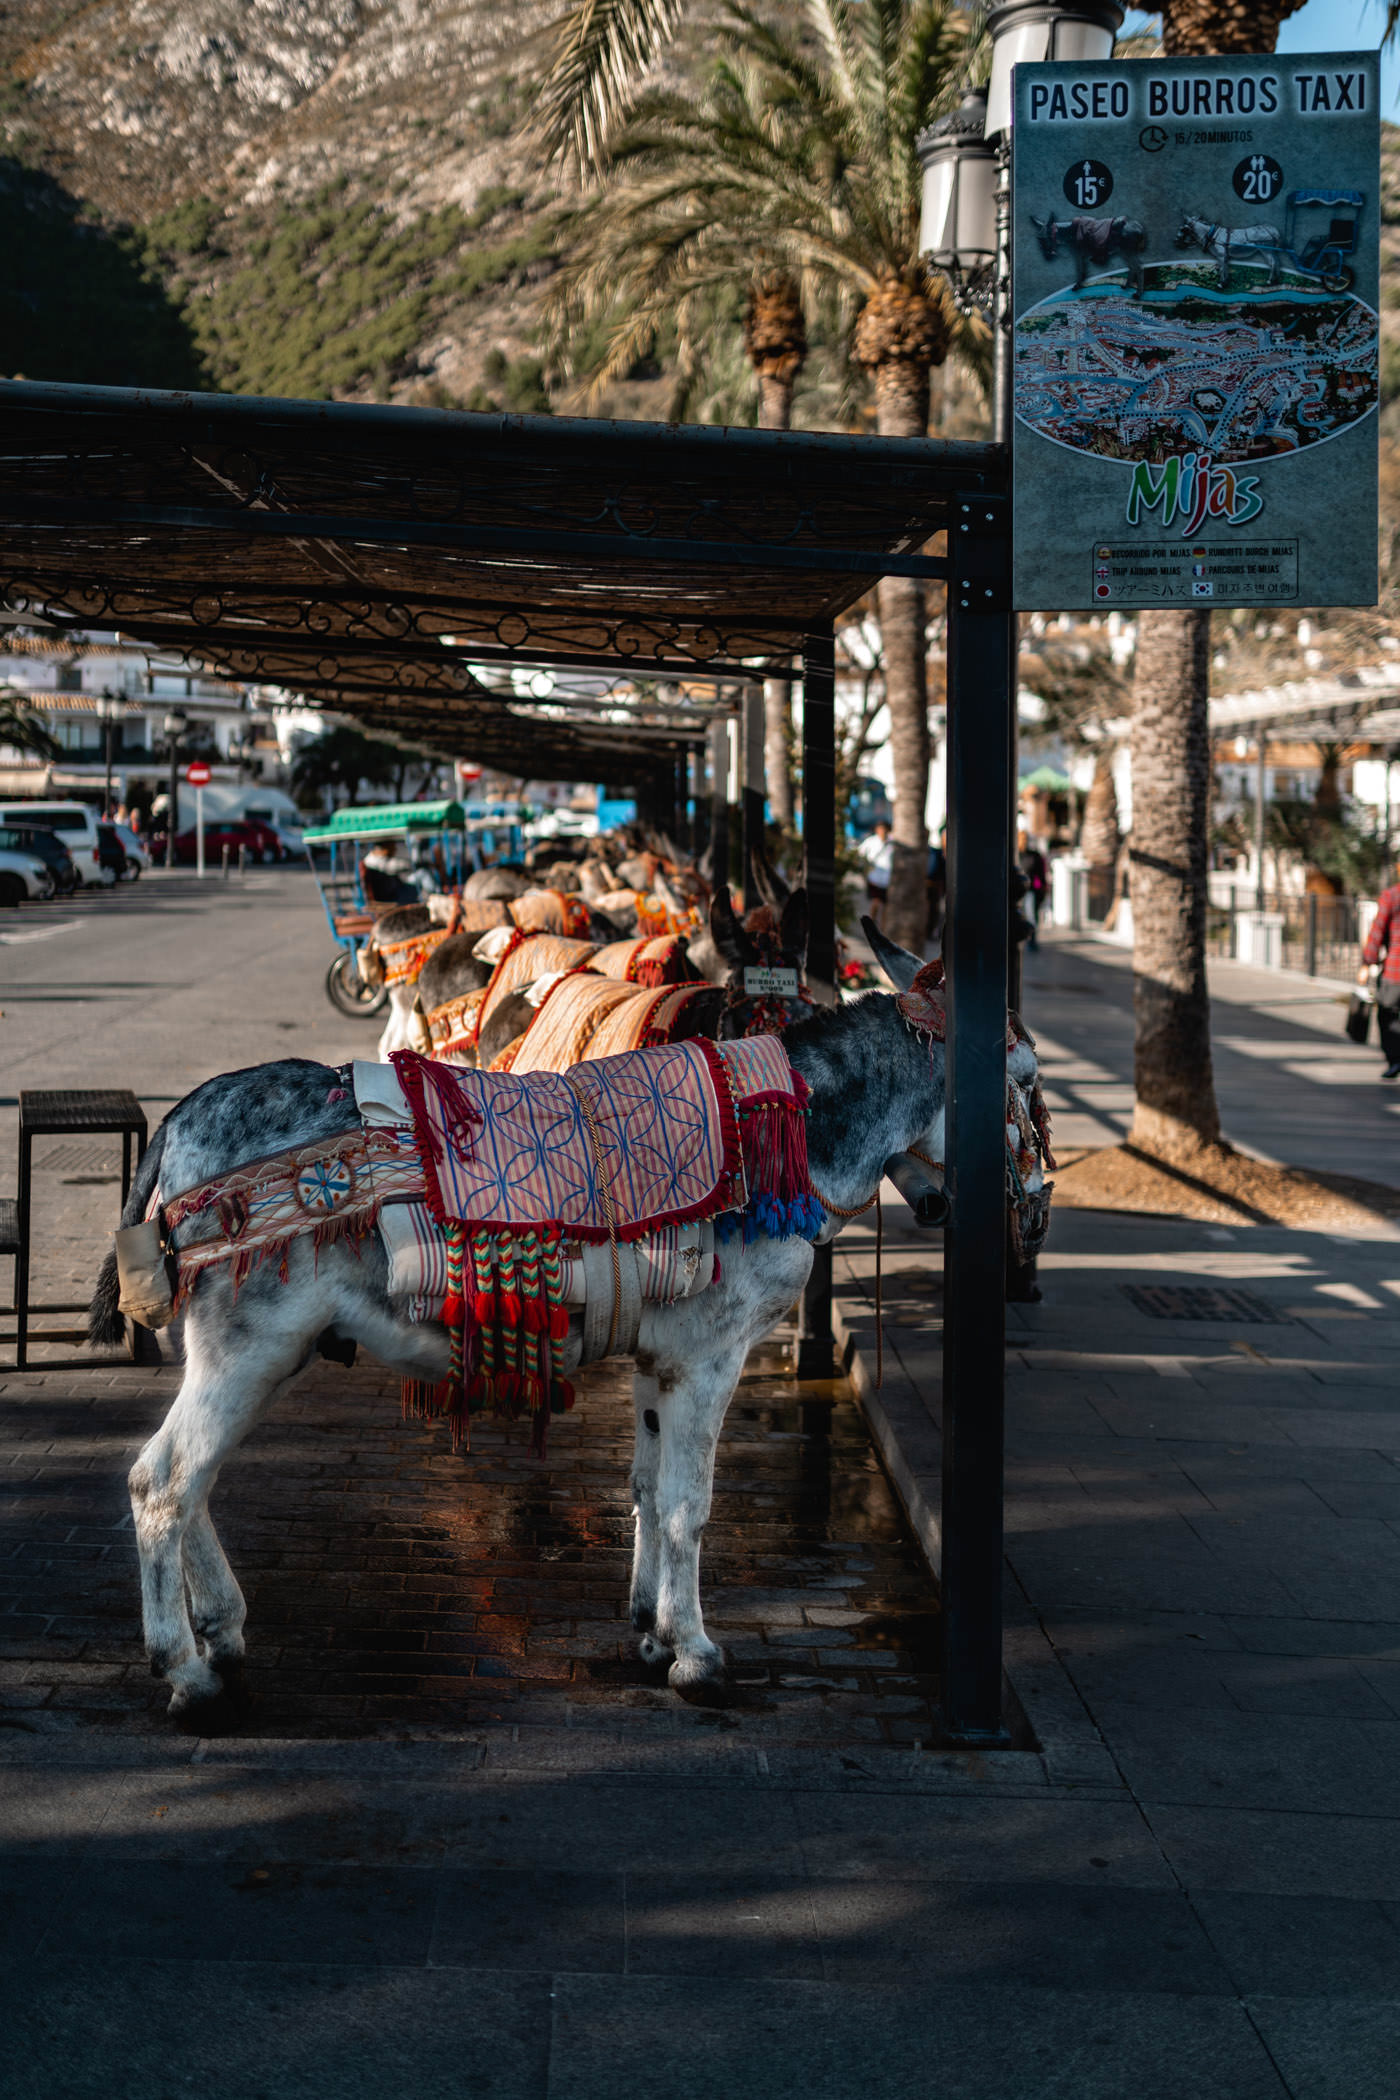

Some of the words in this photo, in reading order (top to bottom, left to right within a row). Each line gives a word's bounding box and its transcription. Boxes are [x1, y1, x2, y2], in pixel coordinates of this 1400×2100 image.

[1030, 81, 1129, 120] PASEO
[1150, 76, 1278, 117] BURROS
[1295, 73, 1366, 112] TAXI
[1126, 452, 1263, 537] Mijas
[1169, 548, 1191, 558] MIJAS
[1271, 546, 1294, 556] MIJAS
[1159, 566, 1181, 576] MIJAS
[1258, 564, 1280, 574] MIJAS
